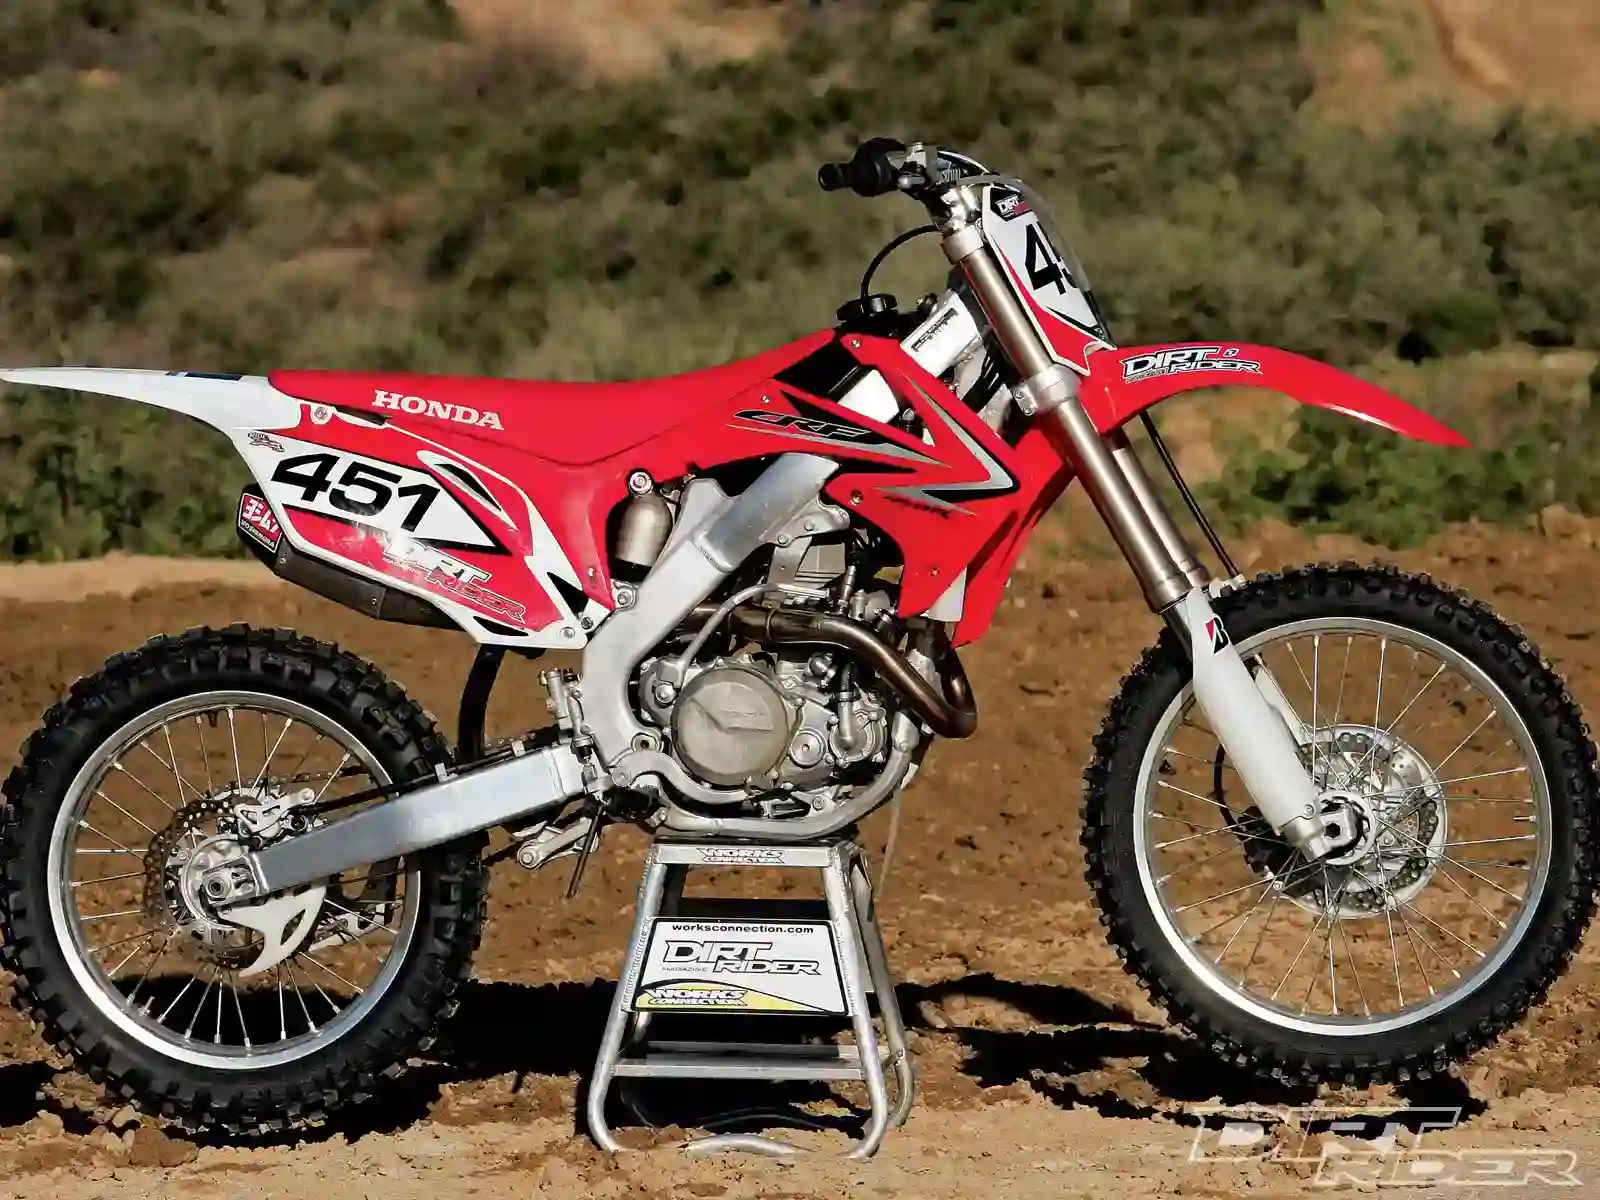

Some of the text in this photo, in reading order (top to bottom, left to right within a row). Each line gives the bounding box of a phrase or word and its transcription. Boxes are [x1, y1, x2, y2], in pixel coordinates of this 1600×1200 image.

[1119, 346, 1221, 379] DIRT
[1168, 359, 1263, 375] RIDER
[371, 389, 504, 430] HONDA
[733, 409, 871, 437] CRF
[270, 452, 441, 532] 451
[672, 924, 814, 934] worksconnection.com
[663, 940, 773, 962] DIRT
[713, 959, 822, 975] RIDER
[645, 988, 748, 1000] WORKS
